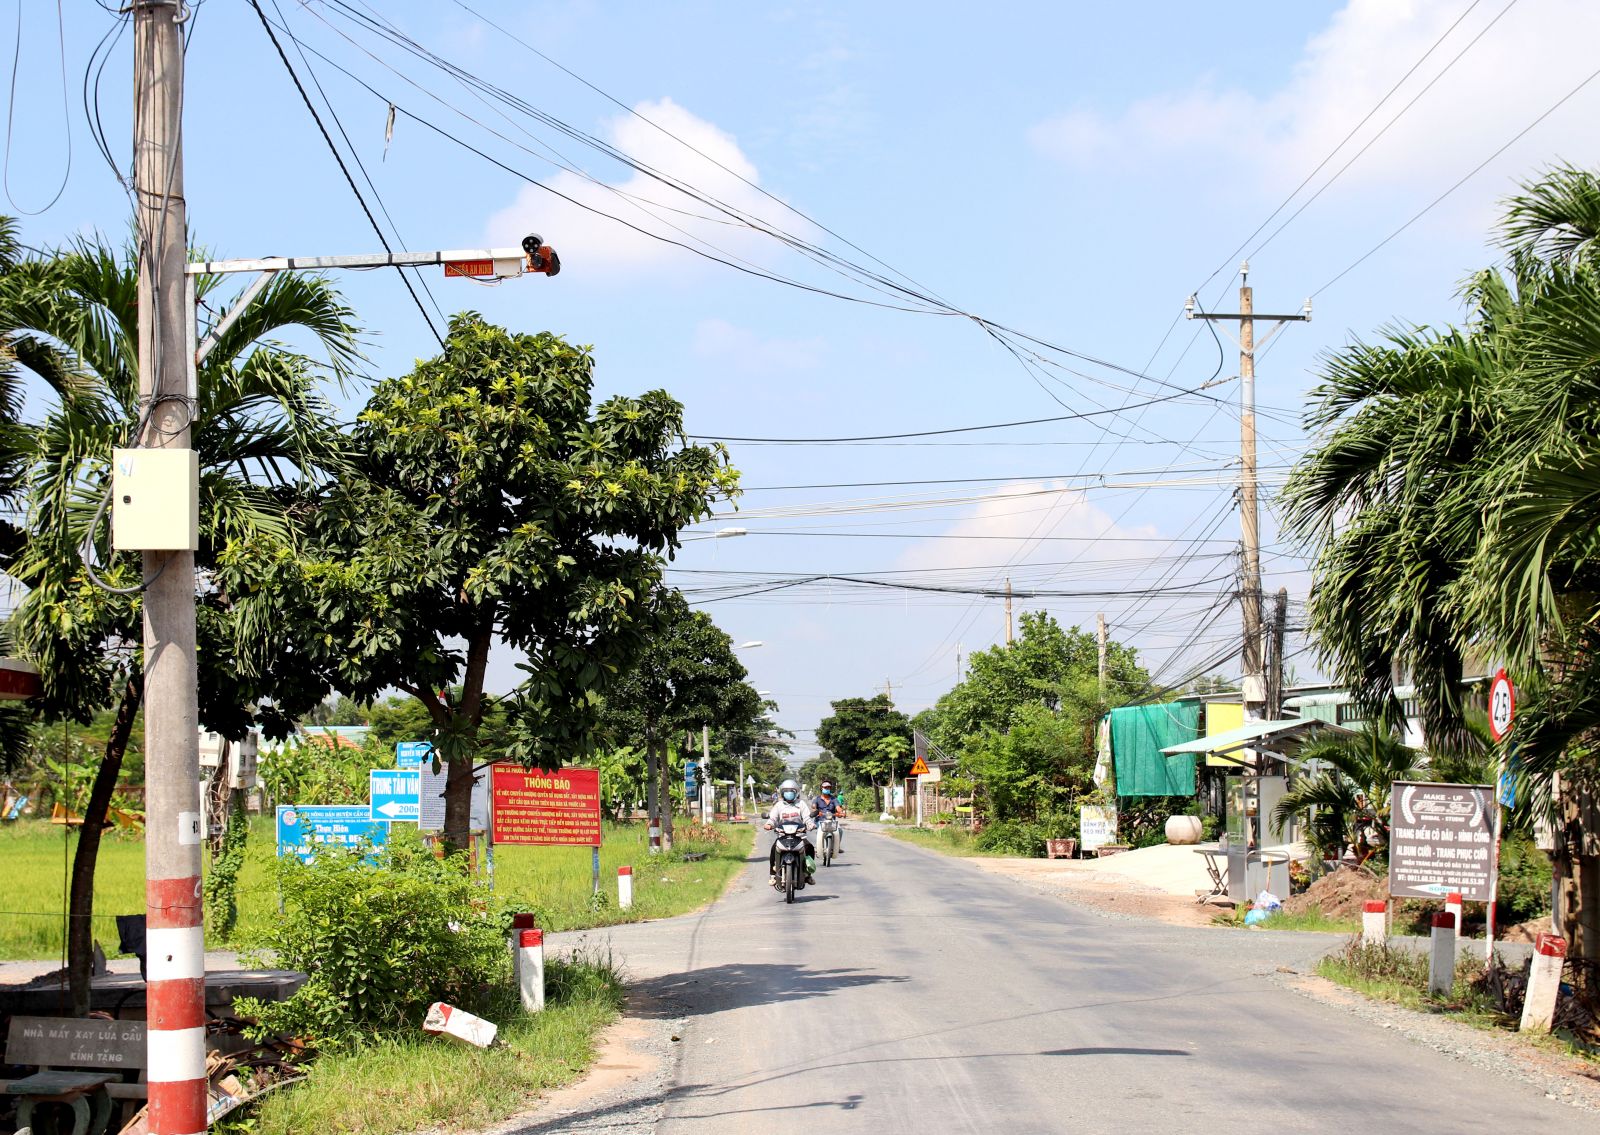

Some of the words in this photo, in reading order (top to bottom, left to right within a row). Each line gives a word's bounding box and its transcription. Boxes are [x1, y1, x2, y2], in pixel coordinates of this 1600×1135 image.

[372, 777, 392, 794] TRUNG
[393, 773, 406, 794] TÂM
[524, 774, 552, 789] THÔNG
[554, 777, 571, 790] BÁO
[1423, 793, 1446, 801] MAKE
[1395, 827, 1415, 839] TRANG
[1415, 824, 1431, 840] ĐIỂM
[1431, 828, 1440, 841] CÔ
[1441, 828, 1454, 842] DÂU
[1458, 829, 1472, 842] HÌNH
[1396, 845, 1417, 857] ALBUM
[1436, 847, 1456, 859] TRANG
[1456, 848, 1473, 861] PHỤC
[24, 1024, 44, 1038] NHÀ
[49, 1024, 70, 1039] MÁY
[75, 1031, 93, 1039] XAY
[121, 1025, 142, 1041] CẦU
[70, 1044, 93, 1062] KÍNH
[97, 1049, 123, 1063] TẶNG
